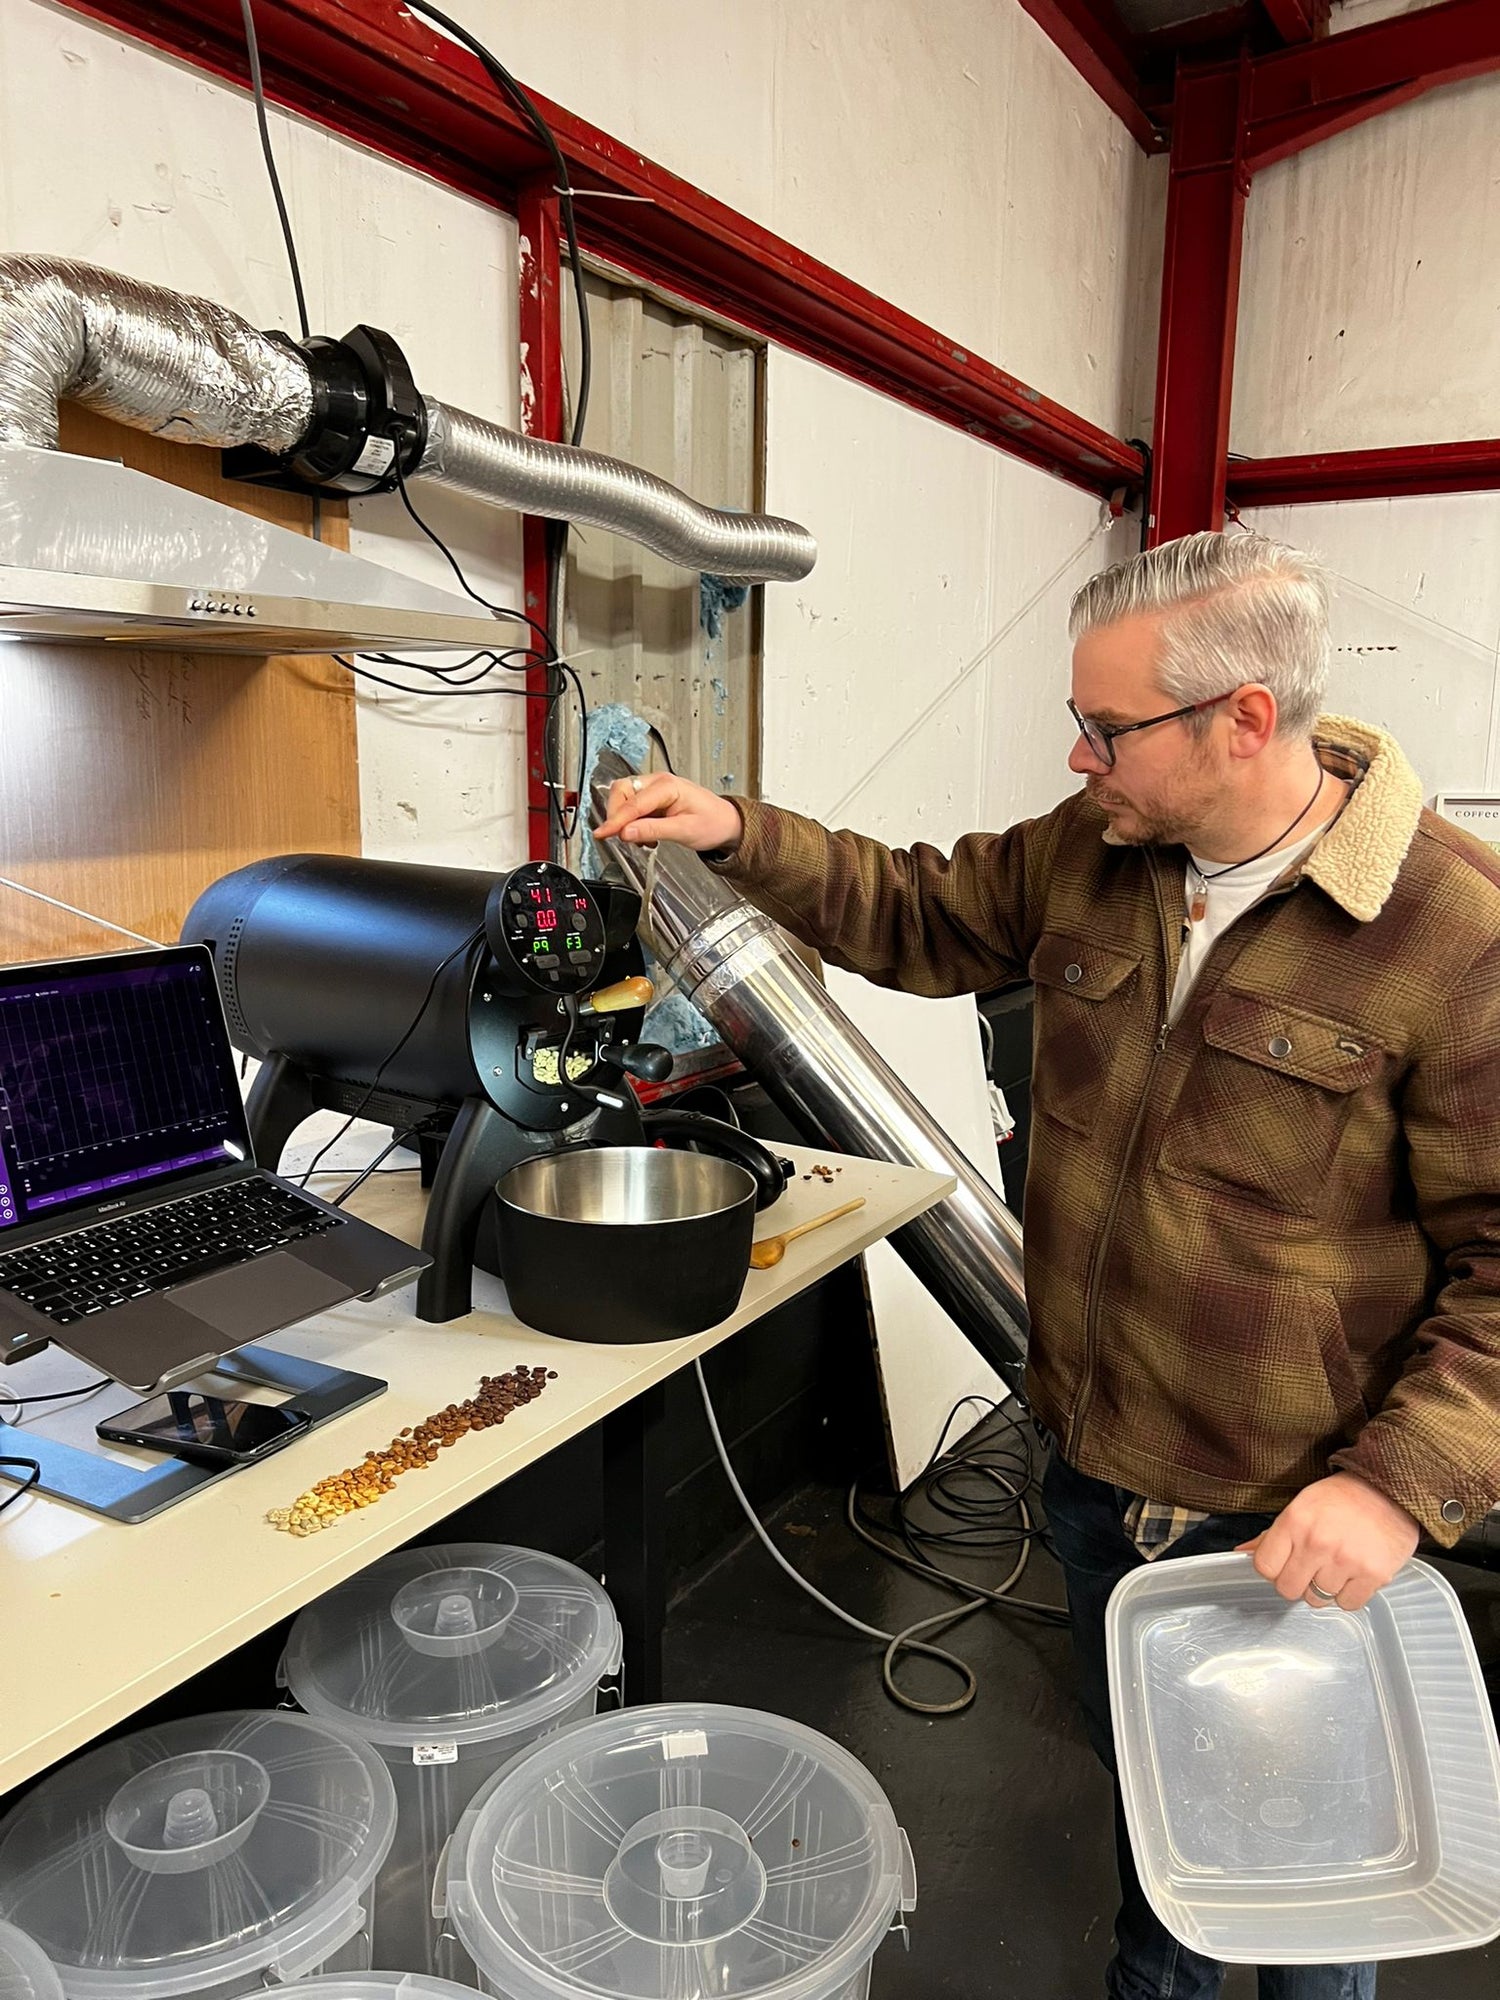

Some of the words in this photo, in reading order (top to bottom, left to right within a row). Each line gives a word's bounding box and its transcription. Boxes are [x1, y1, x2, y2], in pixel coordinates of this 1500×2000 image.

[530, 888, 552, 903] 41
[574, 898, 587, 910] 14
[536, 909, 557, 928] 0.0
[533, 940, 550, 953] P9
[566, 936, 582, 949] F3
